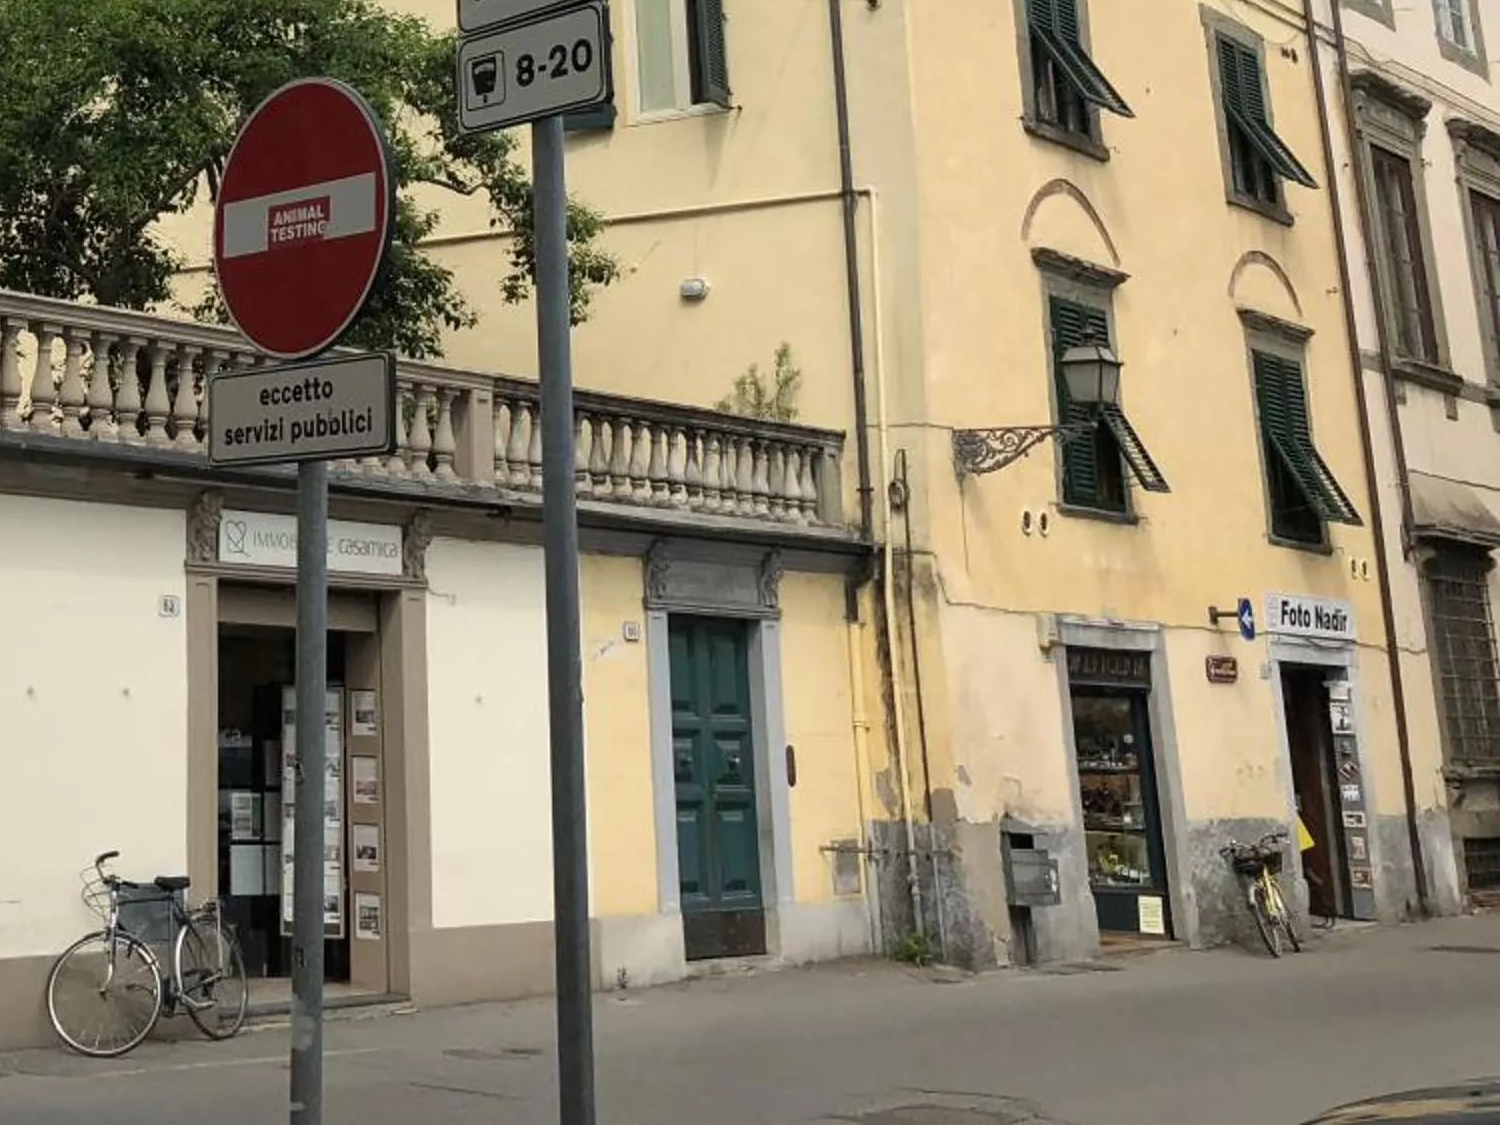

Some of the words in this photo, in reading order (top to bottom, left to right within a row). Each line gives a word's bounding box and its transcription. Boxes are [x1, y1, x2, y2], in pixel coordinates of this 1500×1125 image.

[515, 38, 593, 87] 8-20
[273, 203, 324, 226] ANIMAL
[271, 220, 327, 243] TESTING
[259, 377, 333, 406] eccetto
[225, 416, 284, 446] servizi
[290, 407, 373, 444] pubblici
[338, 537, 398, 559] casamica
[1280, 600, 1311, 628] Foto
